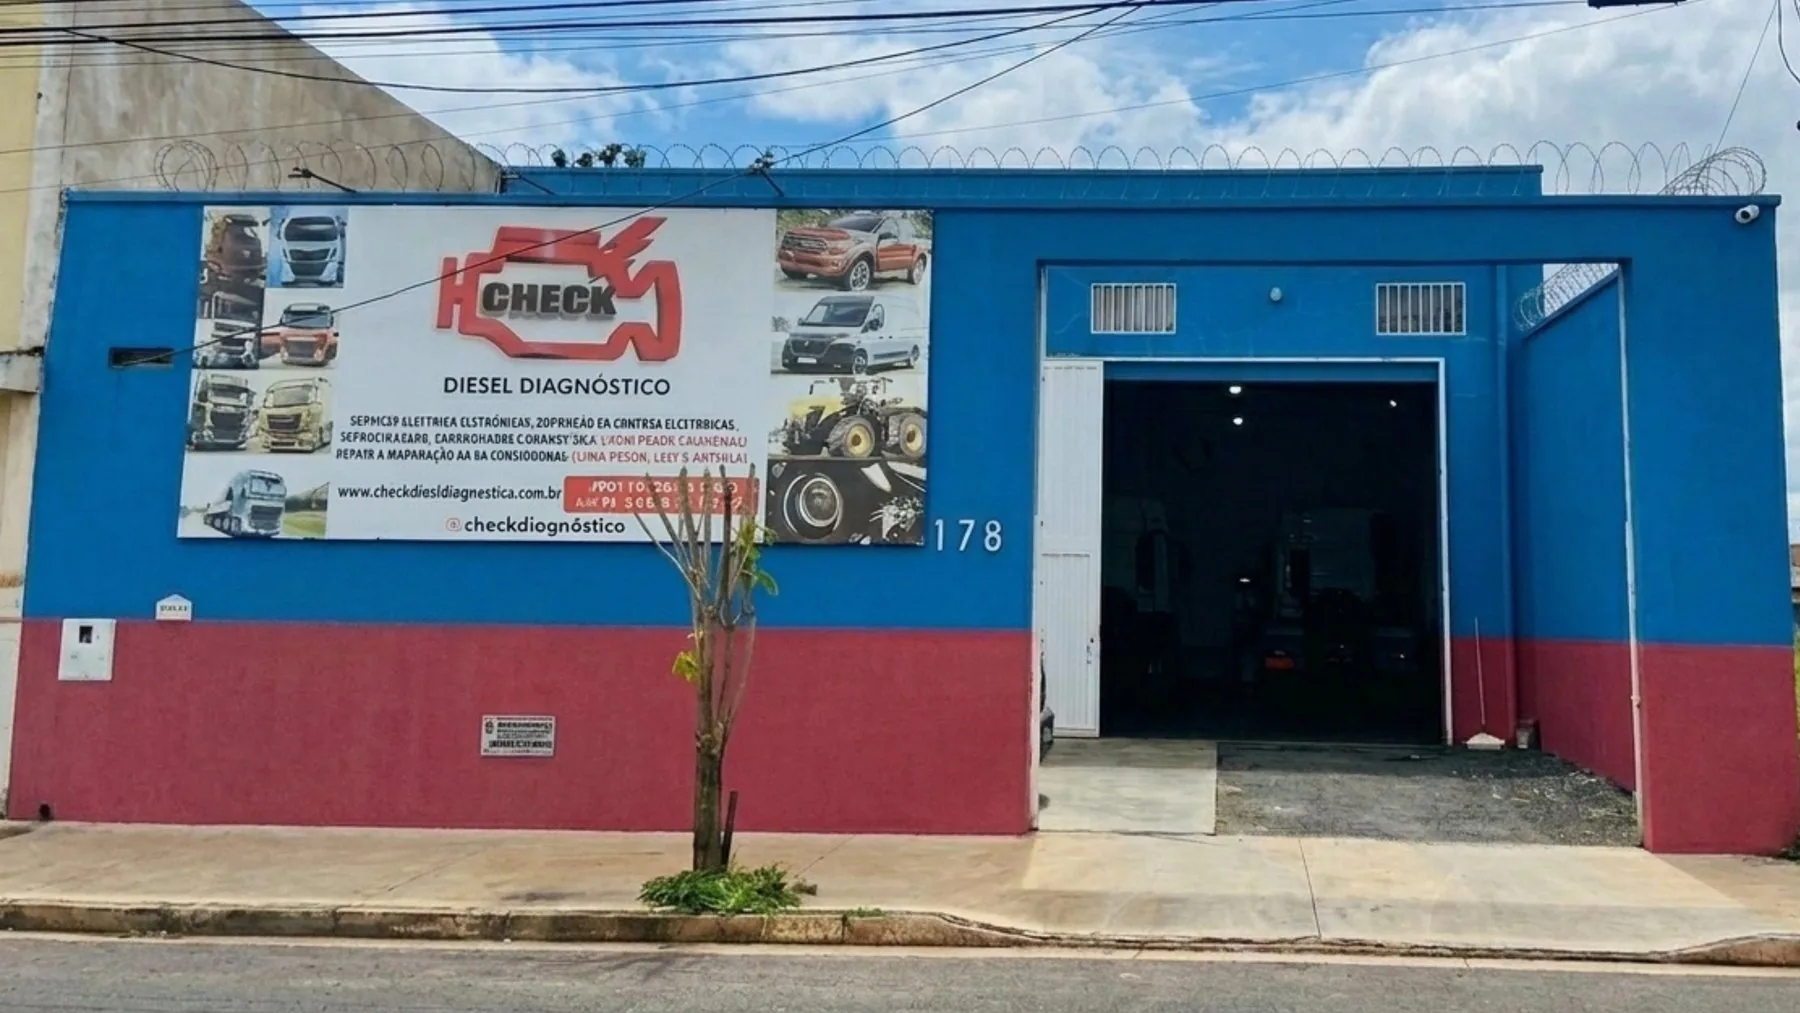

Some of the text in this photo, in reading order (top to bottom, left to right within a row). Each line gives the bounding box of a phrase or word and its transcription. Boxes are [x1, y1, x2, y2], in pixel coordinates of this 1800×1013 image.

[481, 282, 617, 318] CHECK
[443, 373, 671, 396] DIESEL DIAGNÓSTICO
[377, 449, 385, 460] A
[464, 515, 626, 537] checkdiognóstico
[934, 519, 1002, 552] 178
